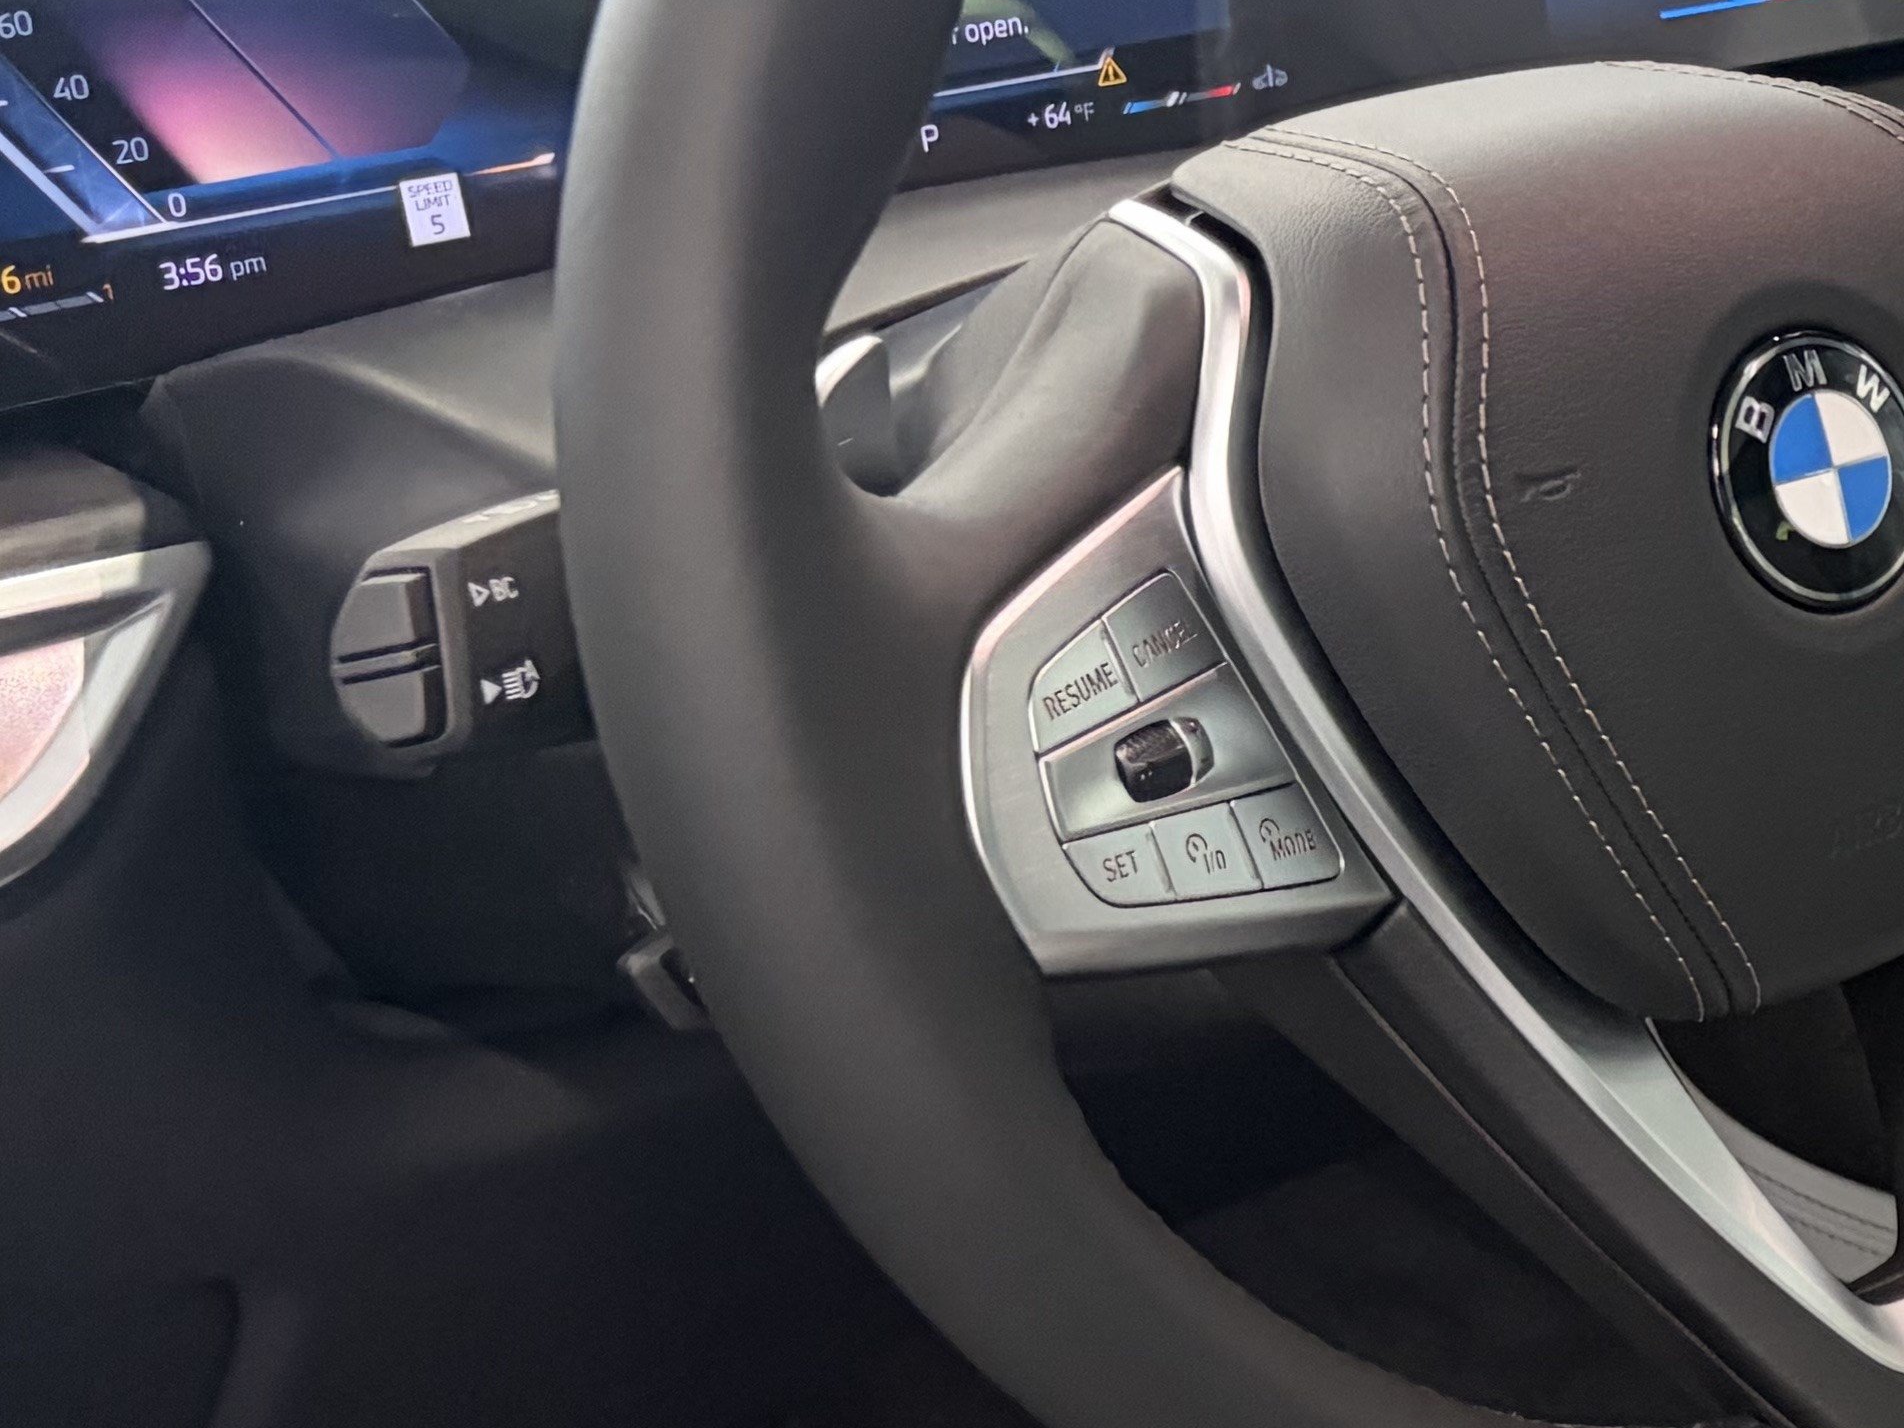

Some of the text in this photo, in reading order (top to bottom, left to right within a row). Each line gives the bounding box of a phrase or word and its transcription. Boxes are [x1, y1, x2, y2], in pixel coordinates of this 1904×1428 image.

[0, 9, 34, 40] 60
[964, 16, 1030, 47] open.
[53, 73, 91, 101] 40
[112, 136, 150, 165] 20
[920, 124, 939, 153] P
[408, 179, 453, 198] SPEED
[415, 193, 451, 212] LIMIT
[167, 192, 188, 218] 0
[430, 213, 446, 236] 5
[159, 253, 268, 292] 3:56 pm
[1735, 349, 1891, 444] BMW
[1131, 619, 1199, 669] CANCEL
[1042, 662, 1119, 721] RESUME
[1270, 827, 1317, 862] MODE
[1102, 849, 1139, 883] SET
